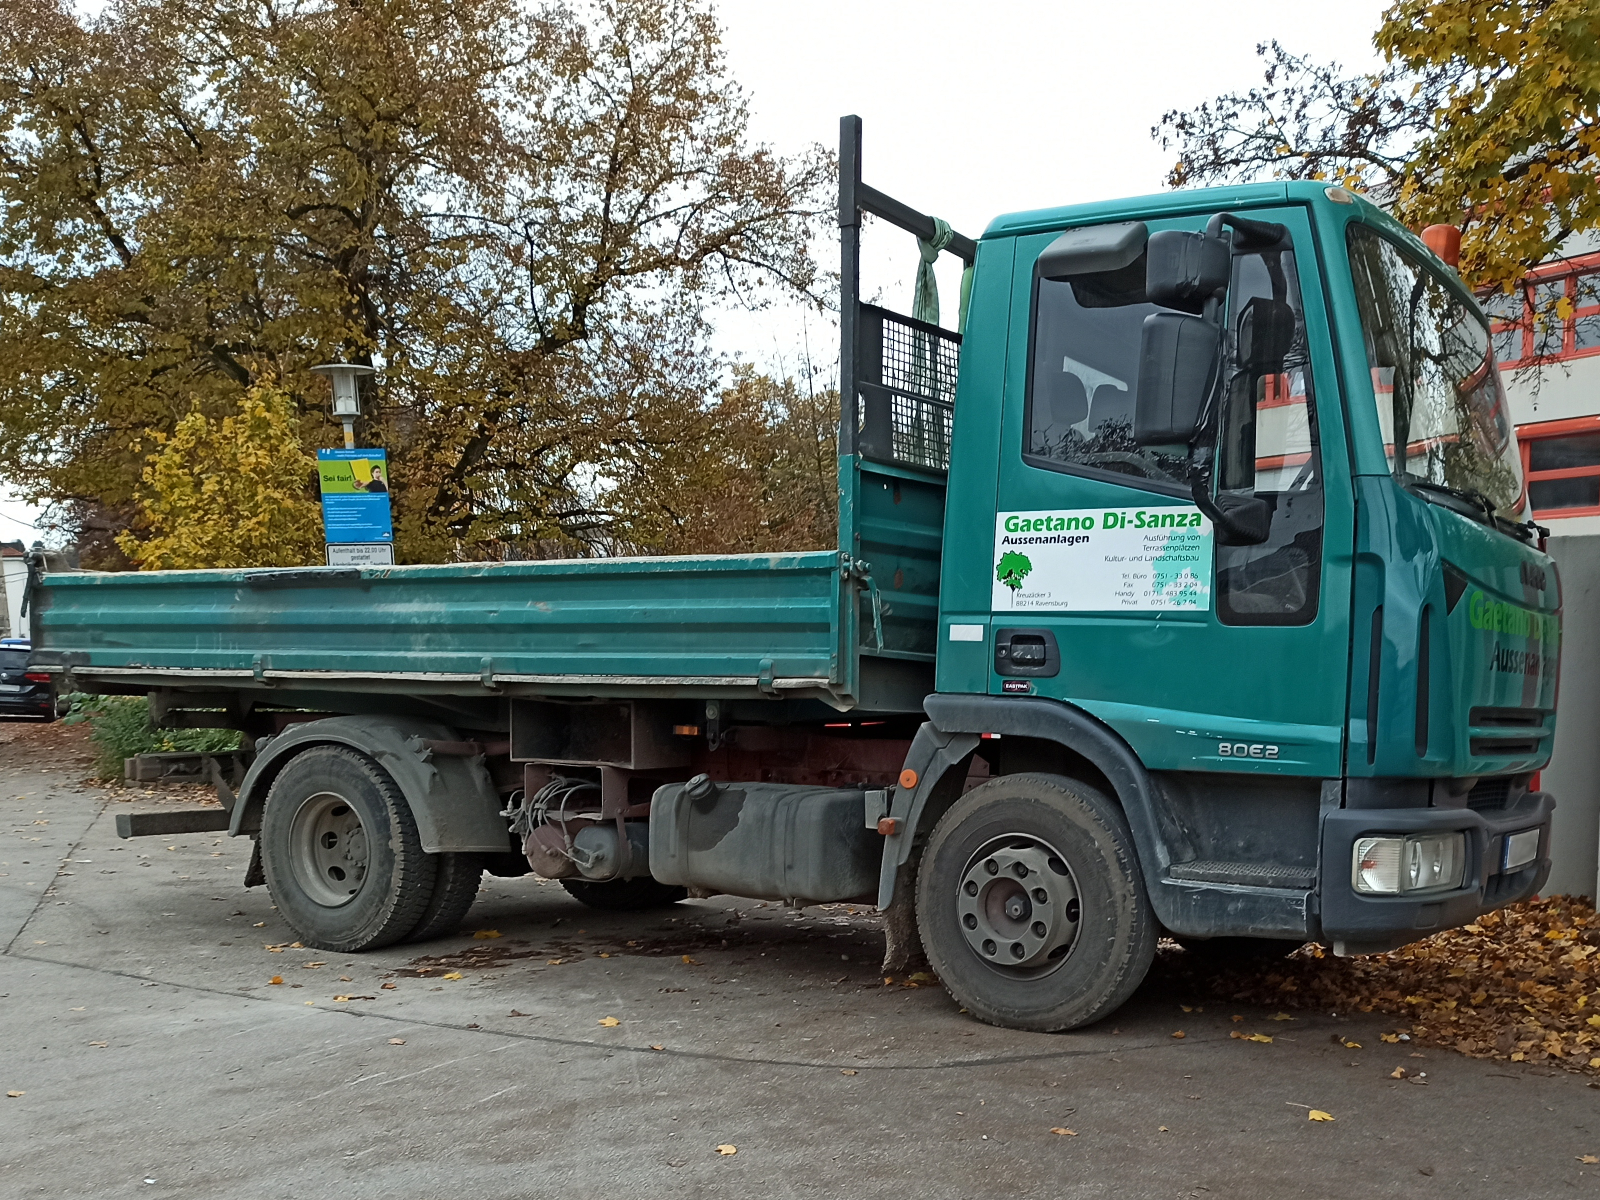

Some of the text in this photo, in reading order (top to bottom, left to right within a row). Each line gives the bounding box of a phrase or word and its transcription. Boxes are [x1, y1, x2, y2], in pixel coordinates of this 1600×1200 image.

[1004, 511, 1202, 533] Gaetano Di-Sanza
[1001, 534, 1090, 546] Aussenanlagen
[1143, 534, 1185, 542] Ausführung
[1143, 544, 1200, 553] Terrassenplätzen
[1145, 554, 1199, 562] Landschaftsbau
[1115, 590, 1135, 598] Handy
[1218, 742, 1279, 759] 80E2
